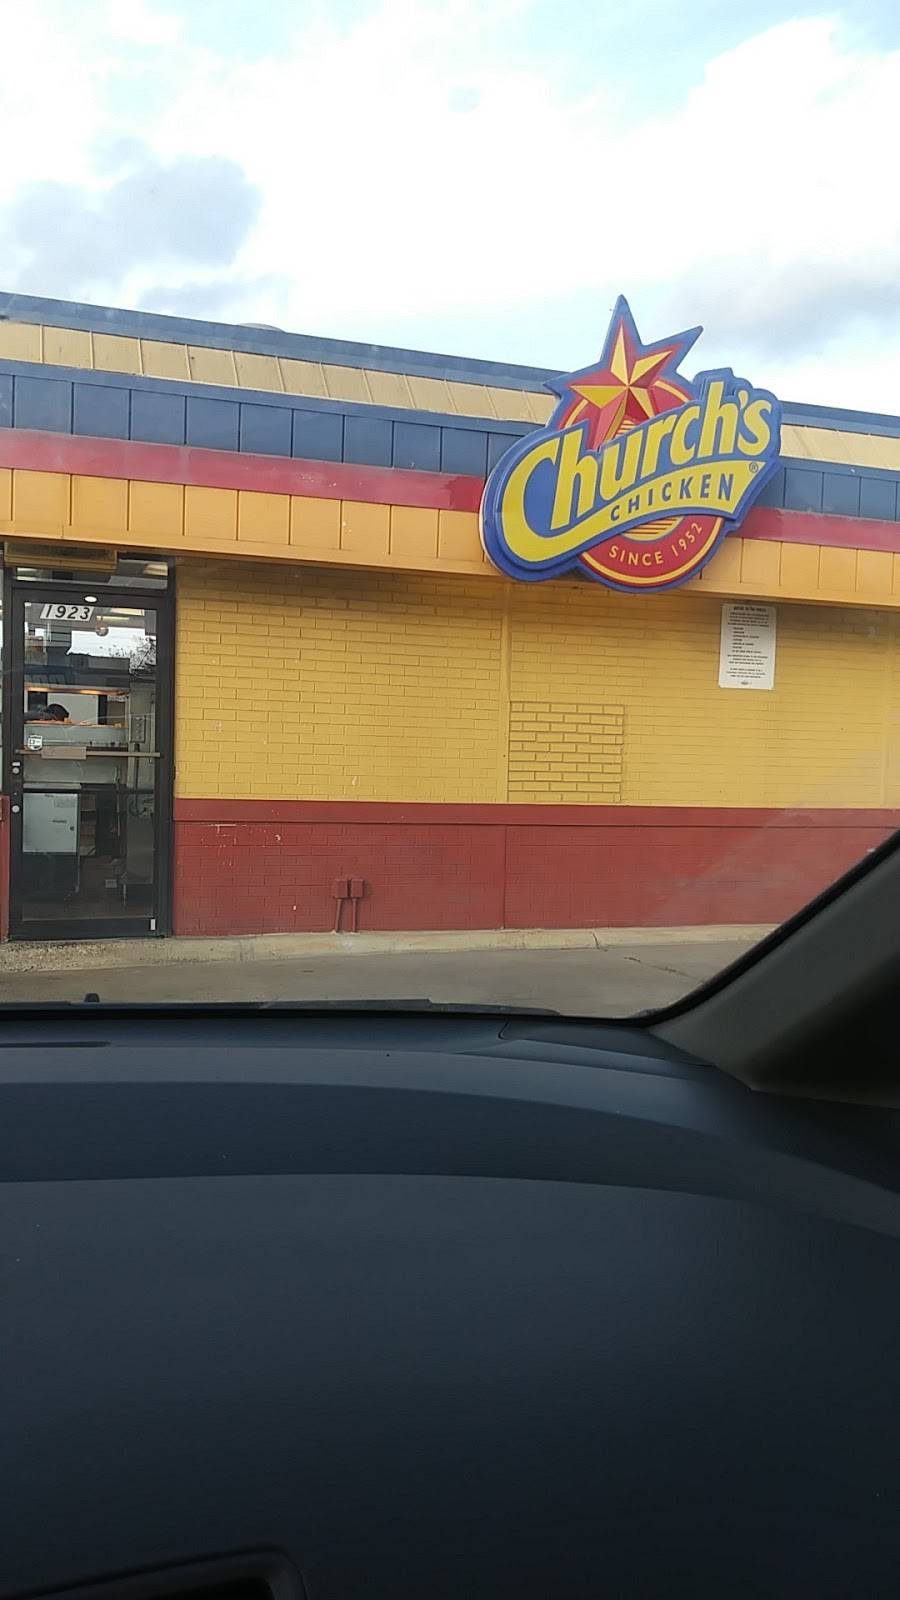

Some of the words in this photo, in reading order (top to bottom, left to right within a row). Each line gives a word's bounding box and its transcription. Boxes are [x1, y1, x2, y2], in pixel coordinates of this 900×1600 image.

[502, 381, 772, 562] Church's
[610, 473, 734, 521] CHICKEN
[608, 545, 664, 566] SINCE
[672, 521, 704, 557] 1952
[45, 604, 90, 620] 1923
